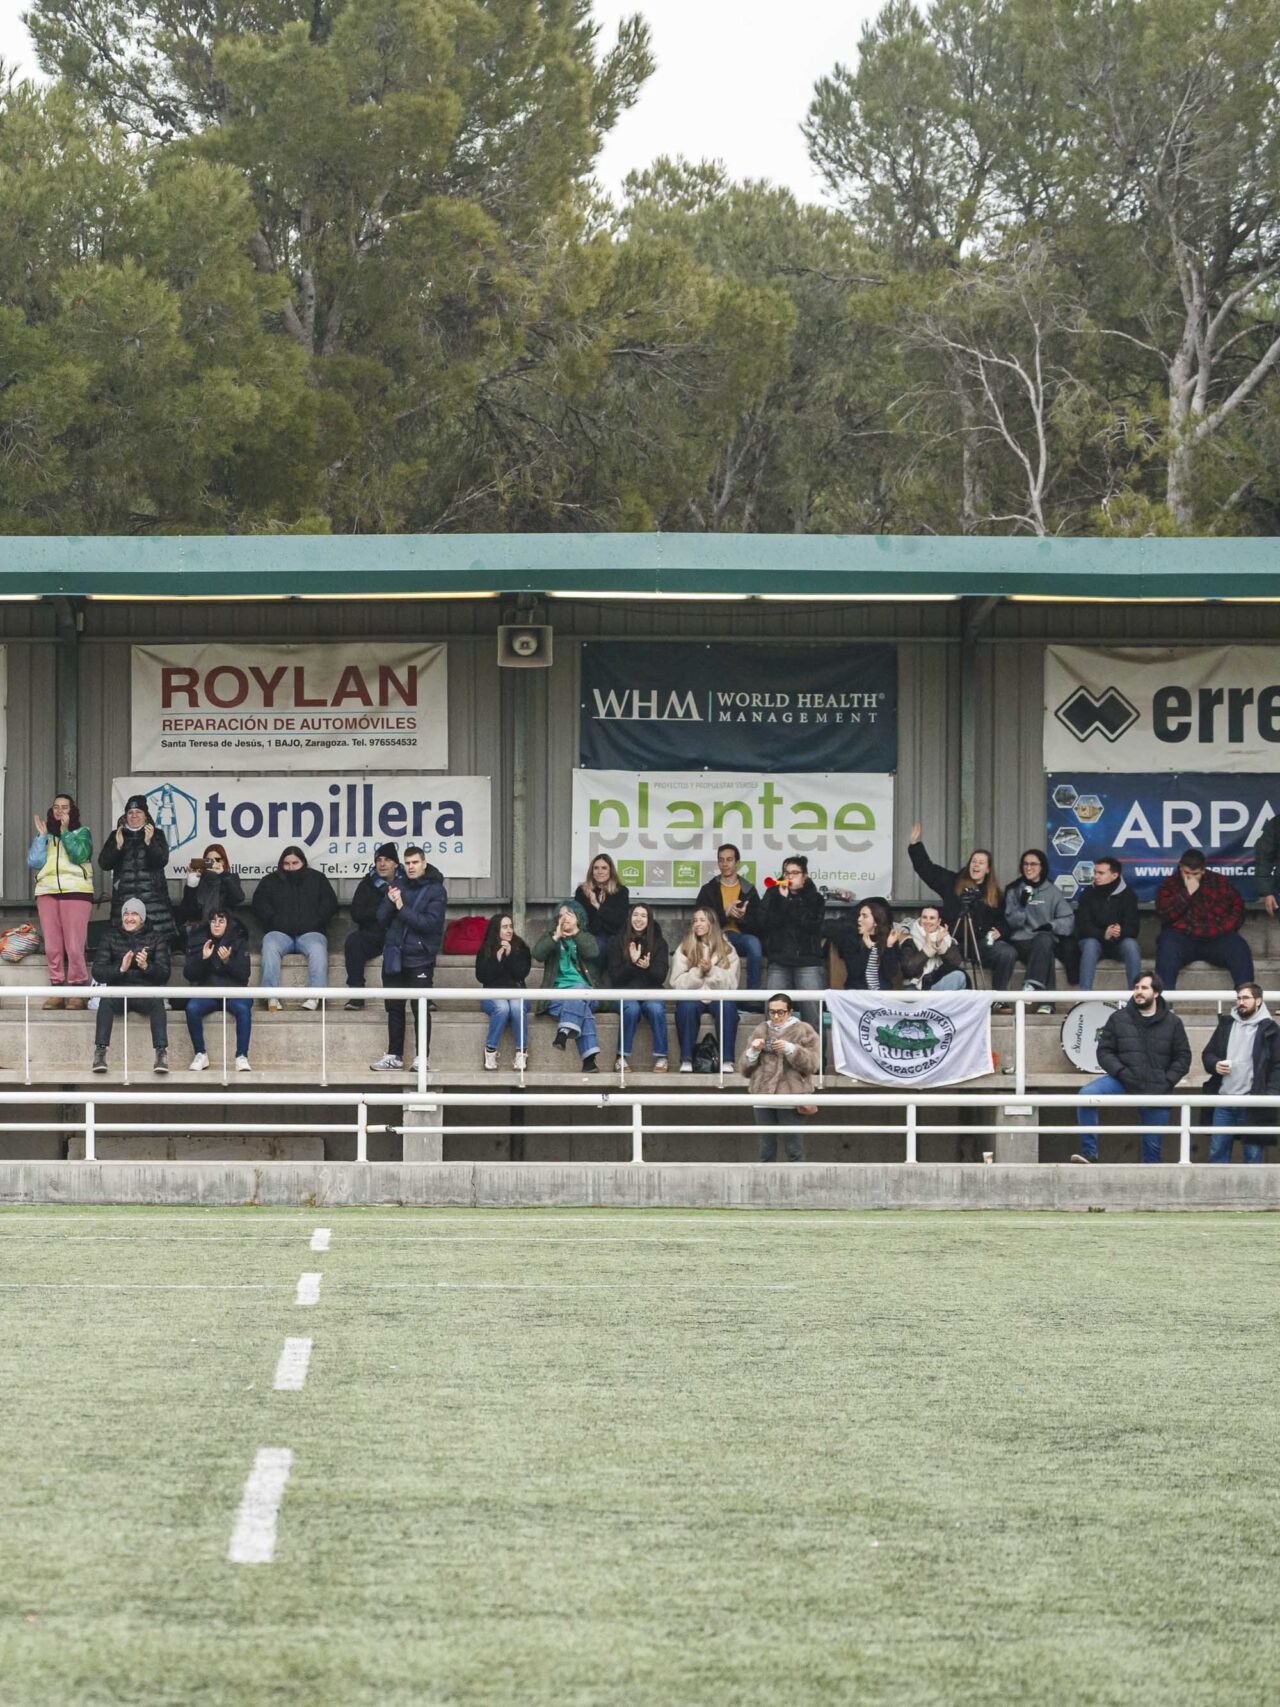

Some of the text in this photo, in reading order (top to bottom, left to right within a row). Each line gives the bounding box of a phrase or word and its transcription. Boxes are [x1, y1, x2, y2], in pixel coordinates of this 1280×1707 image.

[161, 664, 418, 709] ROYLAN
[592, 688, 704, 722] WHM
[717, 691, 790, 708] WORLD
[162, 714, 417, 731] REPARACIÓN DE AUTOMÓVILES
[718, 711, 878, 723] MANAGEMENT
[161, 738, 418, 750] Santa Teresa de Jesús, 1 BAJO, Zaragoza. Tel. 976554532
[205, 783, 464, 847] tornillera
[589, 782, 877, 862] plantae
[878, 1044, 935, 1061] RUGBY
